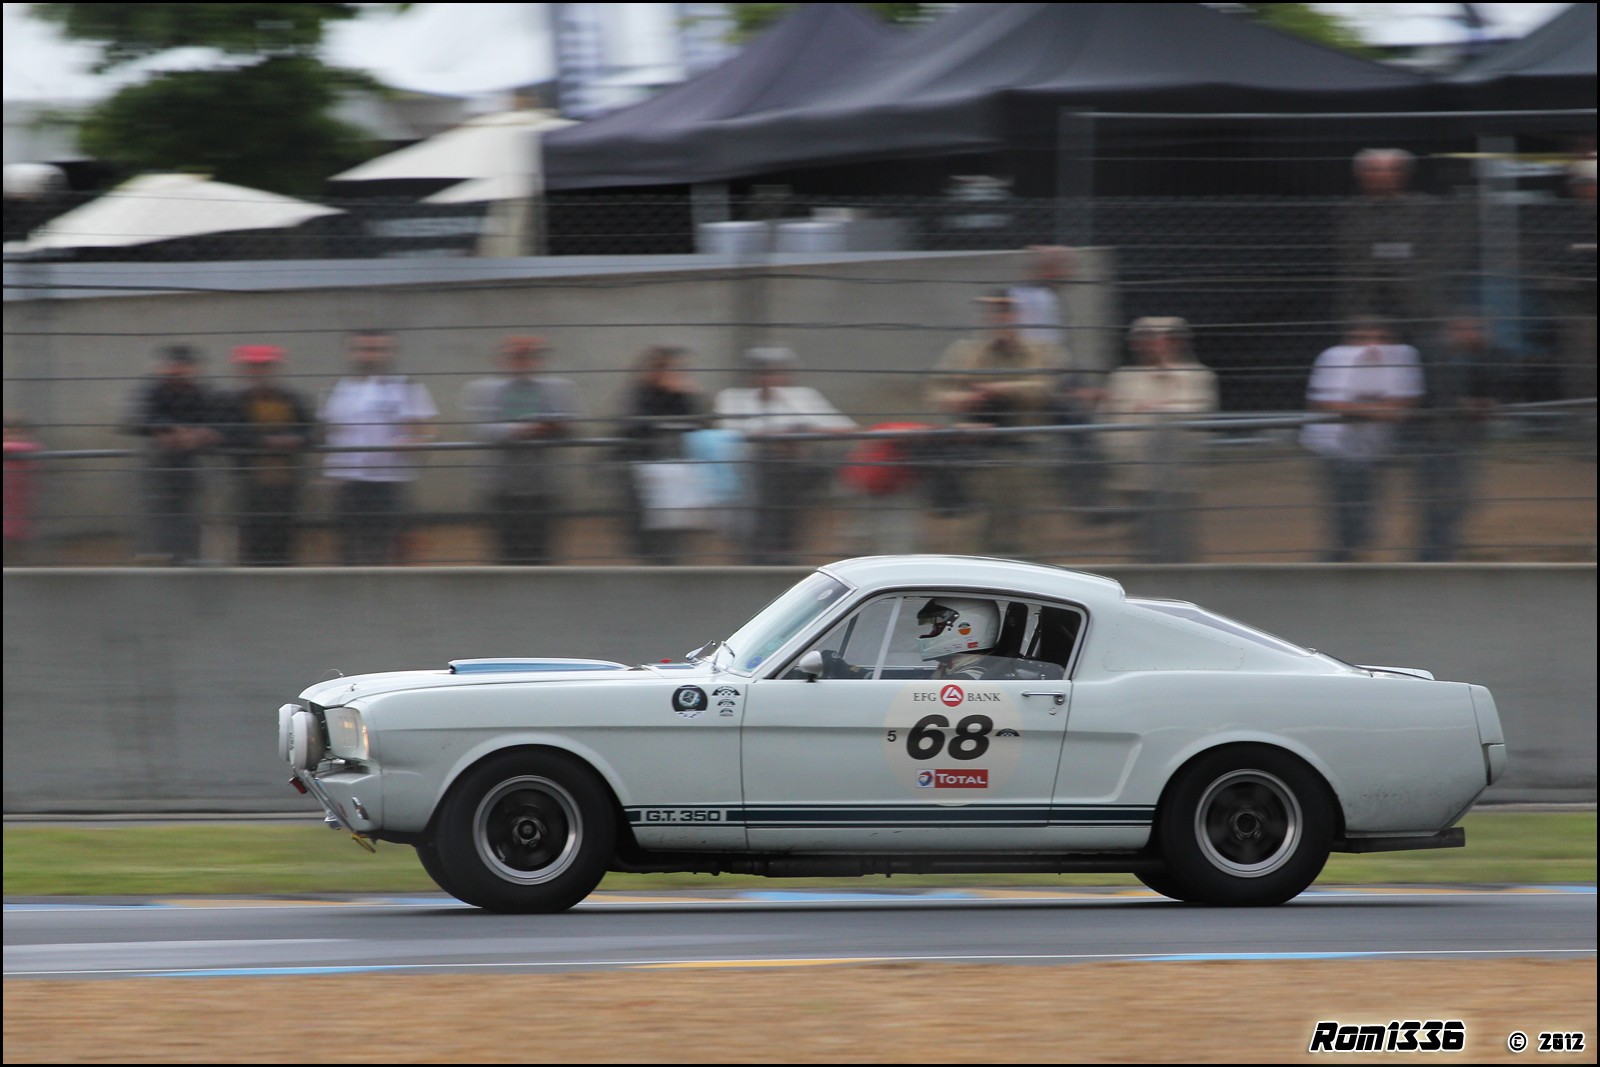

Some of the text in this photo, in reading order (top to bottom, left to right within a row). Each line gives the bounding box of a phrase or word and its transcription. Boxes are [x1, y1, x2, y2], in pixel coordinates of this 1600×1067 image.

[913, 692, 1001, 702] EFG BANK
[887, 730, 897, 742] 5
[906, 714, 994, 760] 68
[936, 773, 987, 785] TOTAL
[646, 810, 721, 821] G.T. 350
